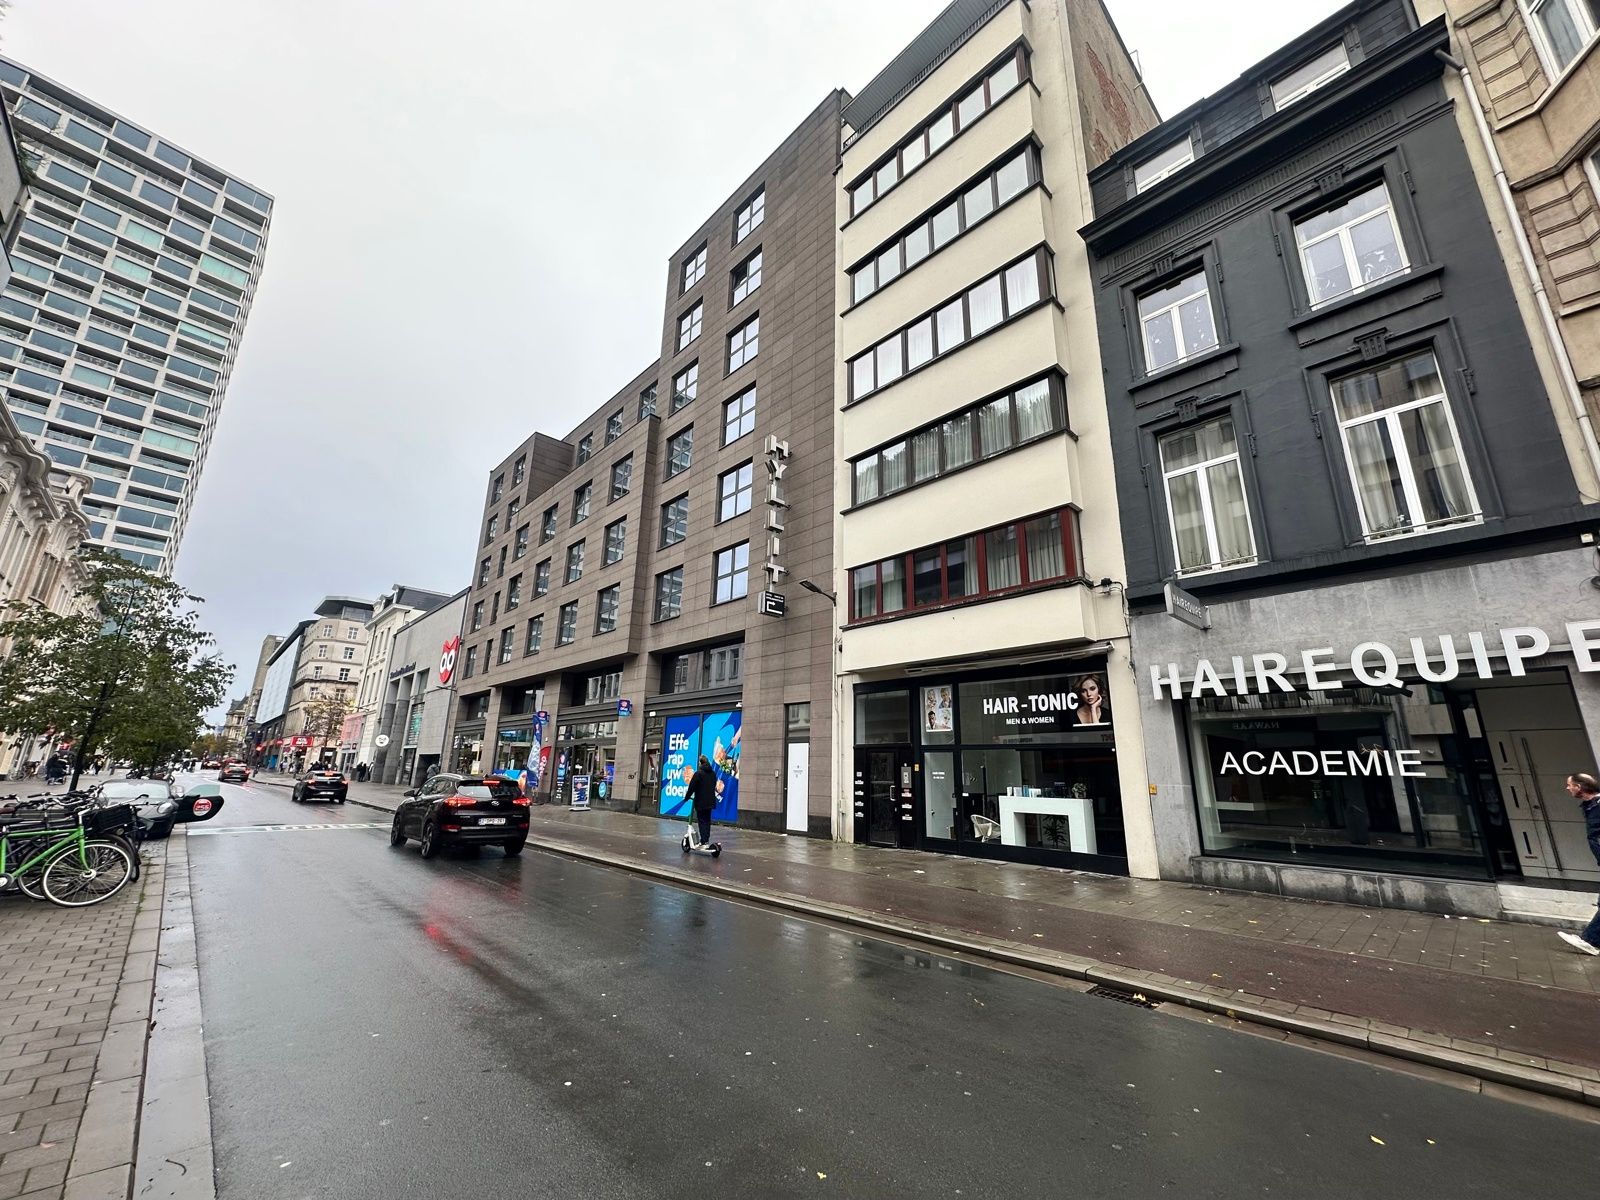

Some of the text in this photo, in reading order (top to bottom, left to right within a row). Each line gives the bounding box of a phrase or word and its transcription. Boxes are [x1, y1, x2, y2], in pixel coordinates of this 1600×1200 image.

[763, 434, 789, 584] HYLLIT
[1150, 618, 1600, 701] HAIREQUIPE
[1027, 716, 1055, 724] WOMEN
[669, 733, 690, 751] Effe
[667, 754, 684, 769] rap
[1220, 749, 1426, 777] ACADEMIE
[666, 769, 682, 780] uw
